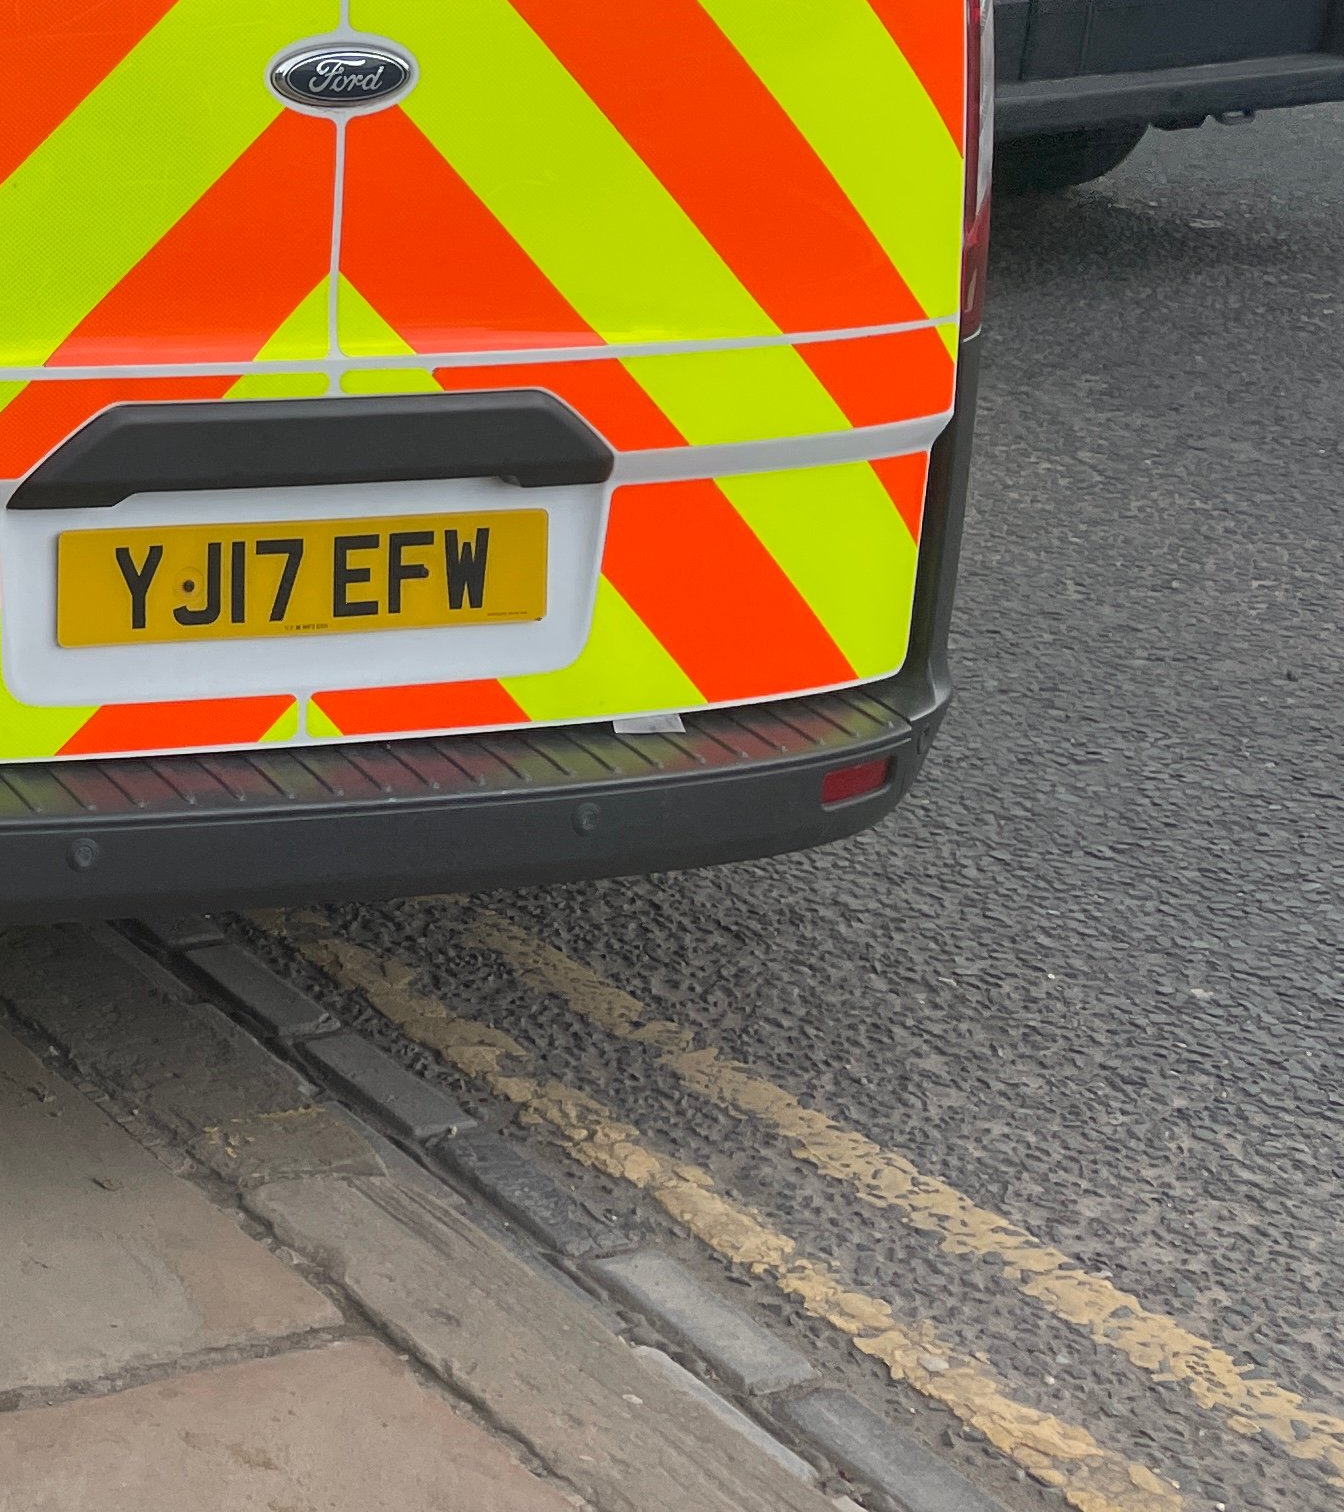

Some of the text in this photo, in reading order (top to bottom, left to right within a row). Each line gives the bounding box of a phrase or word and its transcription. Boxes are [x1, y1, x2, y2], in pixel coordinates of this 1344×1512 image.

[309, 59, 385, 93] Ford
[115, 527, 490, 630] YJ17 EFW
